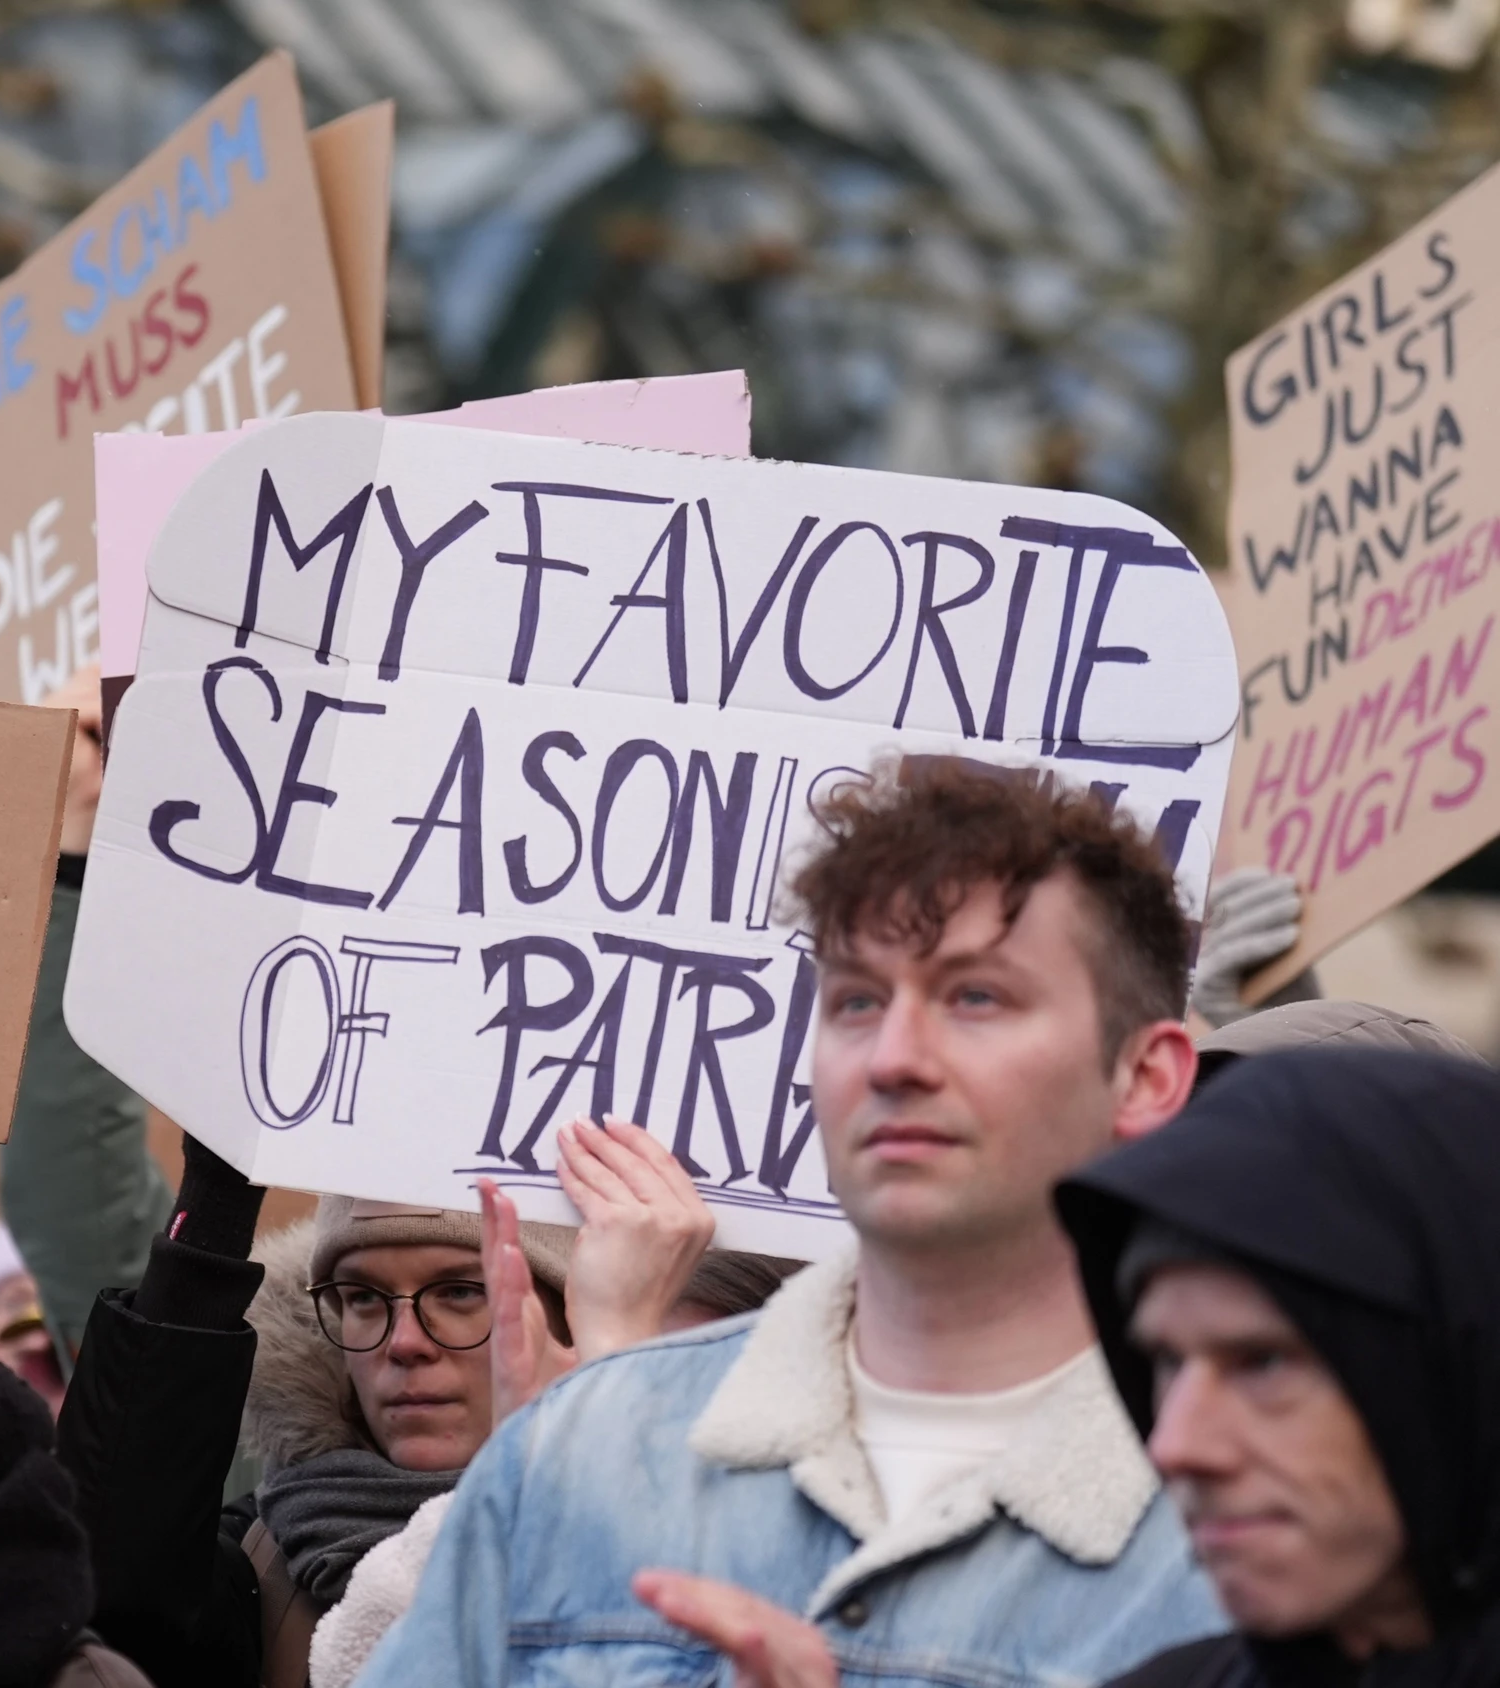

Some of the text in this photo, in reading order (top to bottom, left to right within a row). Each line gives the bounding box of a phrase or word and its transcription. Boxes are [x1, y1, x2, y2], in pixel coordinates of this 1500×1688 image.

[62, 94, 267, 336] SCHAM
[52, 263, 212, 441] MUSS
[117, 303, 302, 435] ITE
[1242, 231, 1457, 428] GIRLS
[1293, 289, 1476, 485] JUST
[1244, 403, 1464, 593] WANNA
[1309, 467, 1461, 627] HAVE
[234, 467, 1200, 772] MY FAVORITE
[148, 656, 758, 922] SEASON
[1240, 614, 1495, 831] HUMAN
[239, 933, 460, 1130] OF
